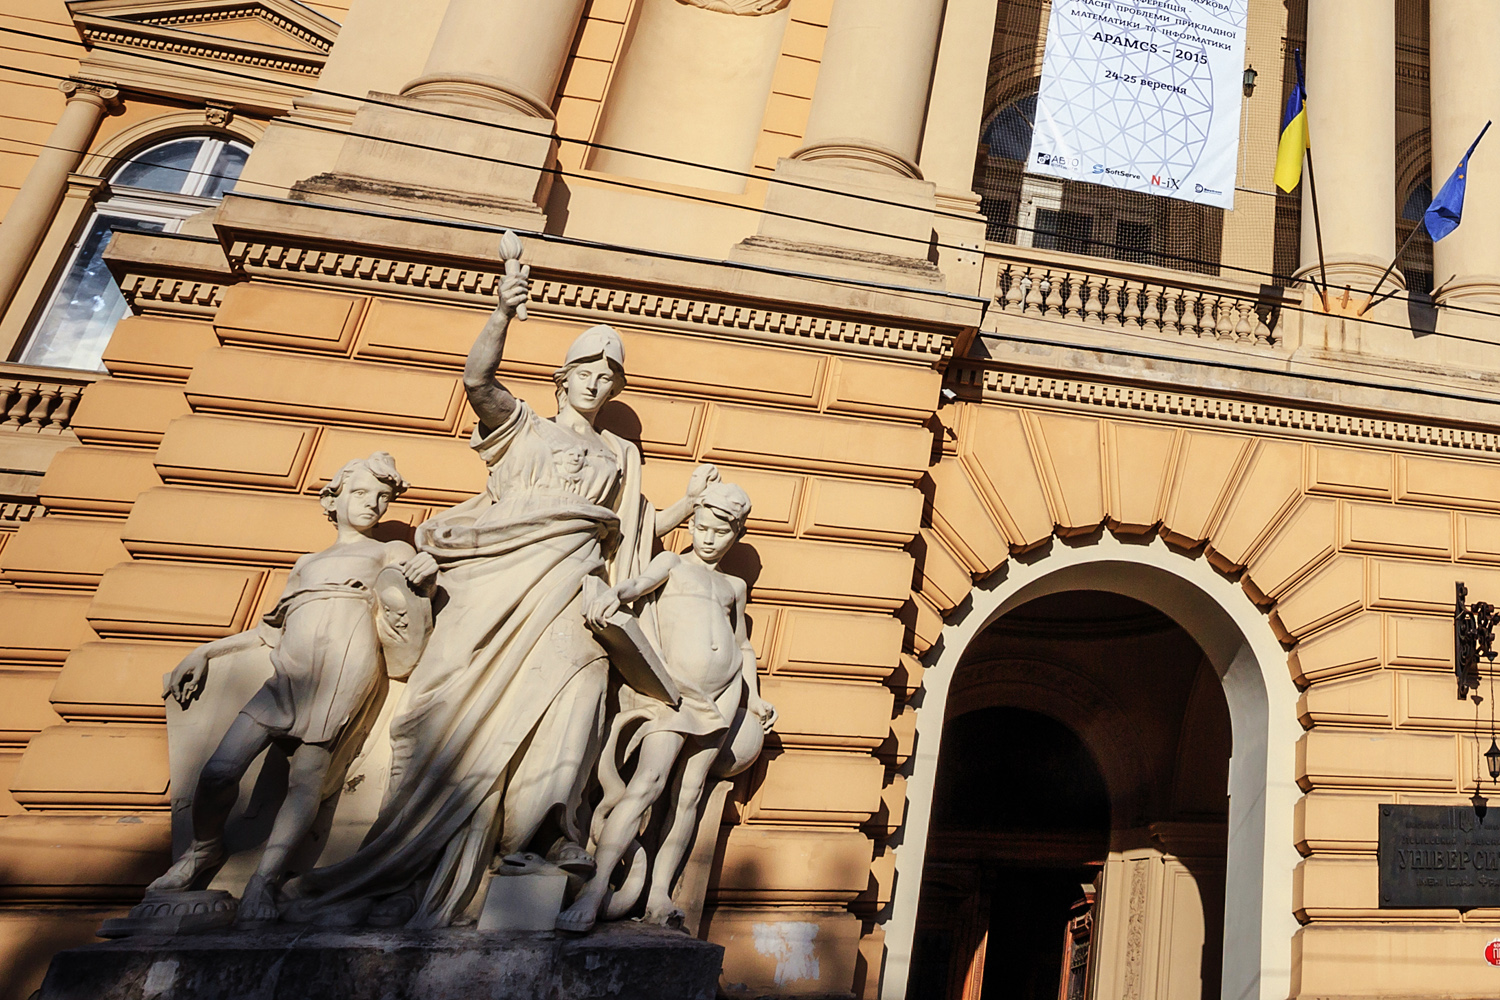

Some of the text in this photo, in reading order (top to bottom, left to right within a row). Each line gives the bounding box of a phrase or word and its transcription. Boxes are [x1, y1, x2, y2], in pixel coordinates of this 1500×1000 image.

[1071, 9, 1140, 28] МАТЕМАТИКИ
[1162, 29, 1231, 51] ІНФОРМАТИКИ
[1116, 5, 1170, 22] ПРОБЛЕМИ
[1175, 18, 1236, 39] ПРИКЛАДНОЇ
[1092, 32, 1158, 53] APAMCS
[1176, 49, 1208, 65] 2015
[1104, 70, 1187, 95] 24-25 вересня
